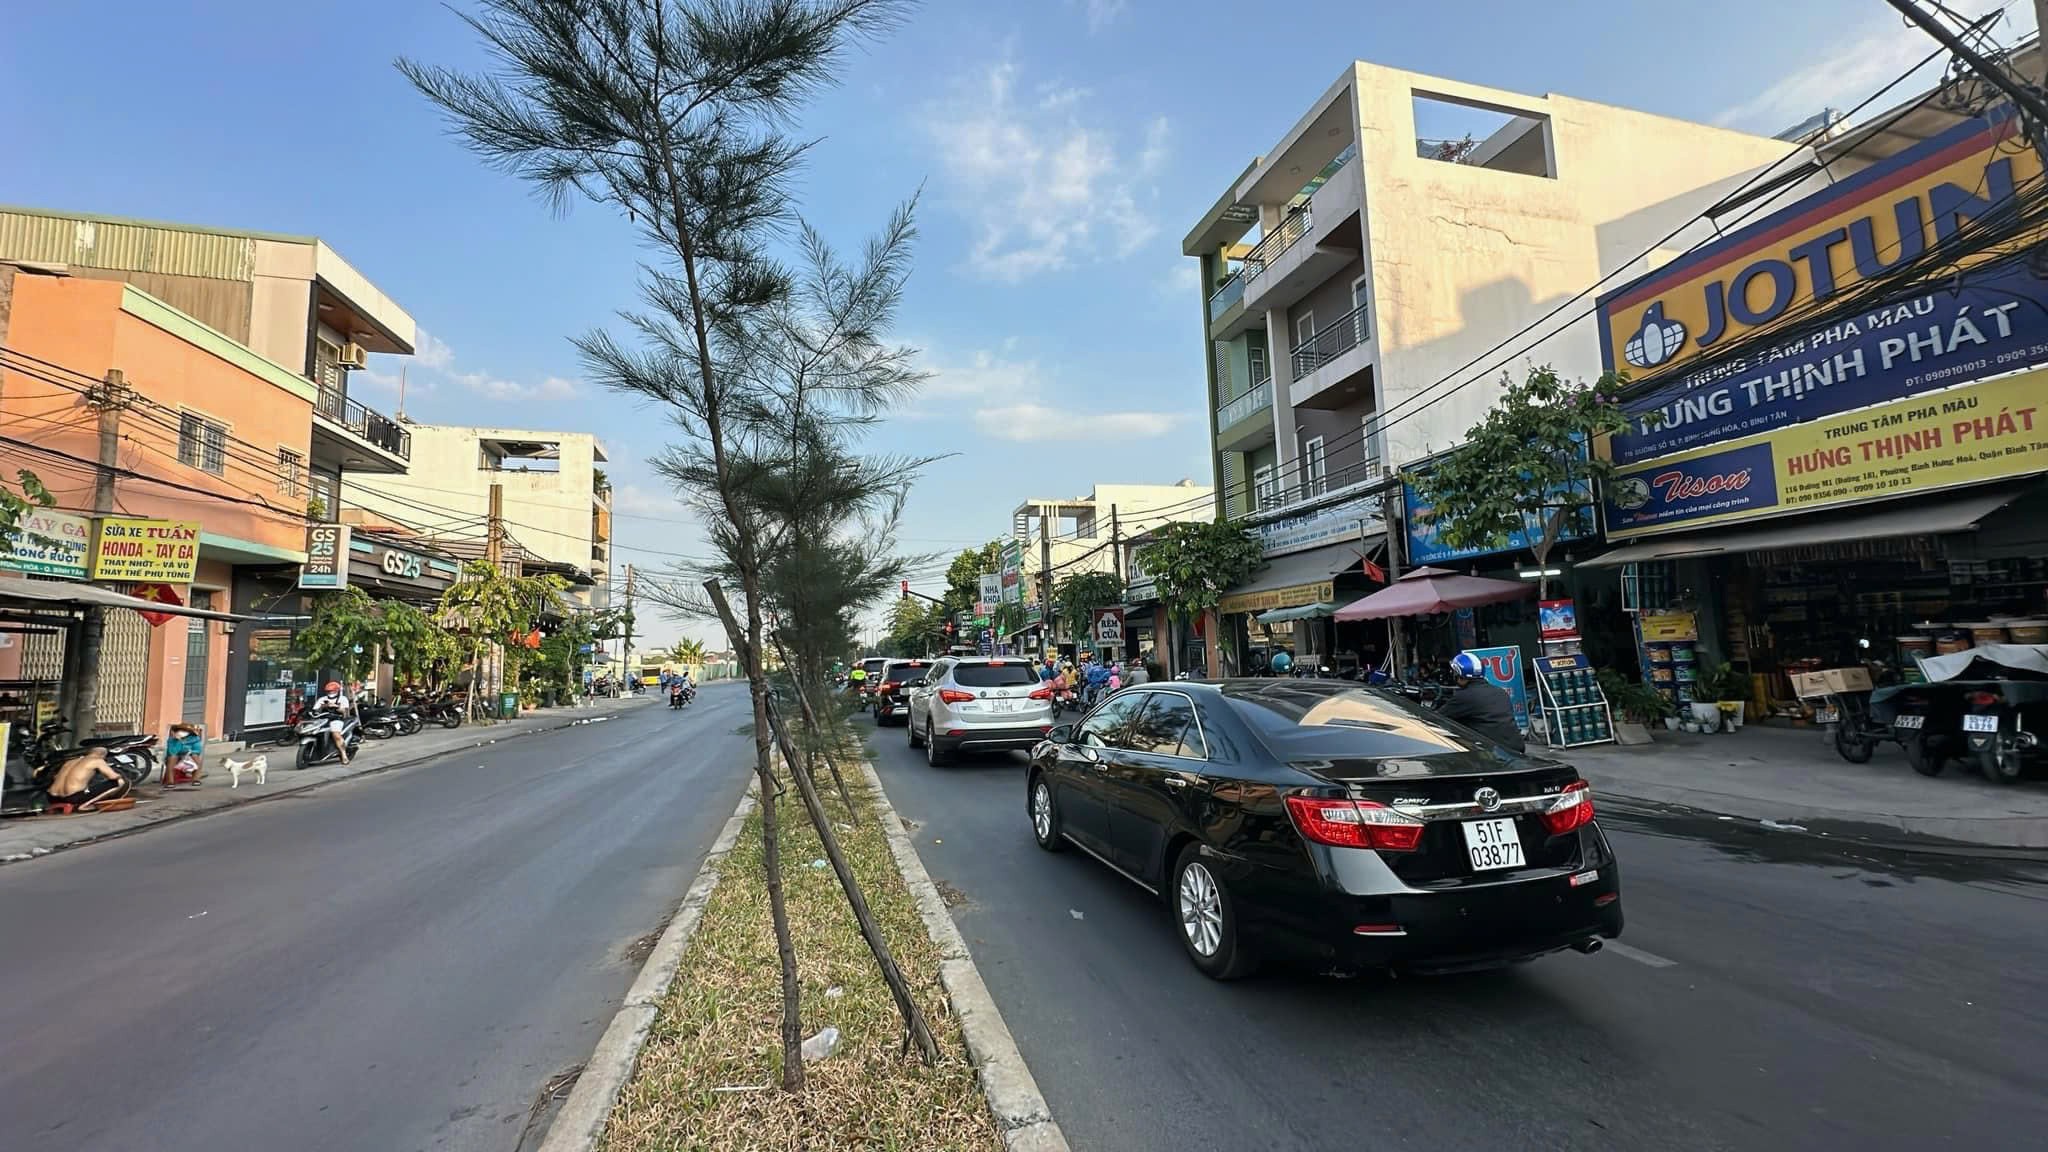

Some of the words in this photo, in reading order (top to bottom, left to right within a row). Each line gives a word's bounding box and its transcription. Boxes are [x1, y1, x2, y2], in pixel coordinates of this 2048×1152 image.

[1696, 157, 2017, 347] JOTUN
[1812, 325, 1861, 352] PHA
[1740, 347, 1866, 409] THỊNH
[1880, 300, 2020, 370] PHÁT
[1996, 349, 2026, 364] 0909
[1824, 421, 1869, 440] TRUNG
[1872, 411, 1904, 431] TÂM
[1907, 405, 1937, 421] PHA
[1942, 396, 1979, 415] MÀU
[1787, 446, 1852, 476] HƯNG
[1857, 427, 1942, 461] THỊNH
[1952, 406, 2037, 444] PHÁT
[1652, 469, 1752, 503] Tison
[1875, 481, 1886, 490] 10
[62, 521, 88, 539] GA
[104, 522, 126, 538] SỬA
[128, 527, 142, 537] XE
[147, 523, 197, 541] TUẤN
[311, 528, 336, 542] GS
[102, 541, 143, 558] HONDA
[156, 543, 175, 559] TAY
[178, 544, 194, 560] GA
[310, 542, 335, 556] 25
[99, 568, 122, 577] THAY
[124, 566, 142, 578] THẾ
[103, 558, 126, 568] THAY
[311, 564, 332, 575] 24h
[383, 549, 422, 579] GS25
[984, 585, 1000, 595] NHA
[1475, 821, 1504, 844] 51F
[1471, 842, 1520, 868] 038.77
